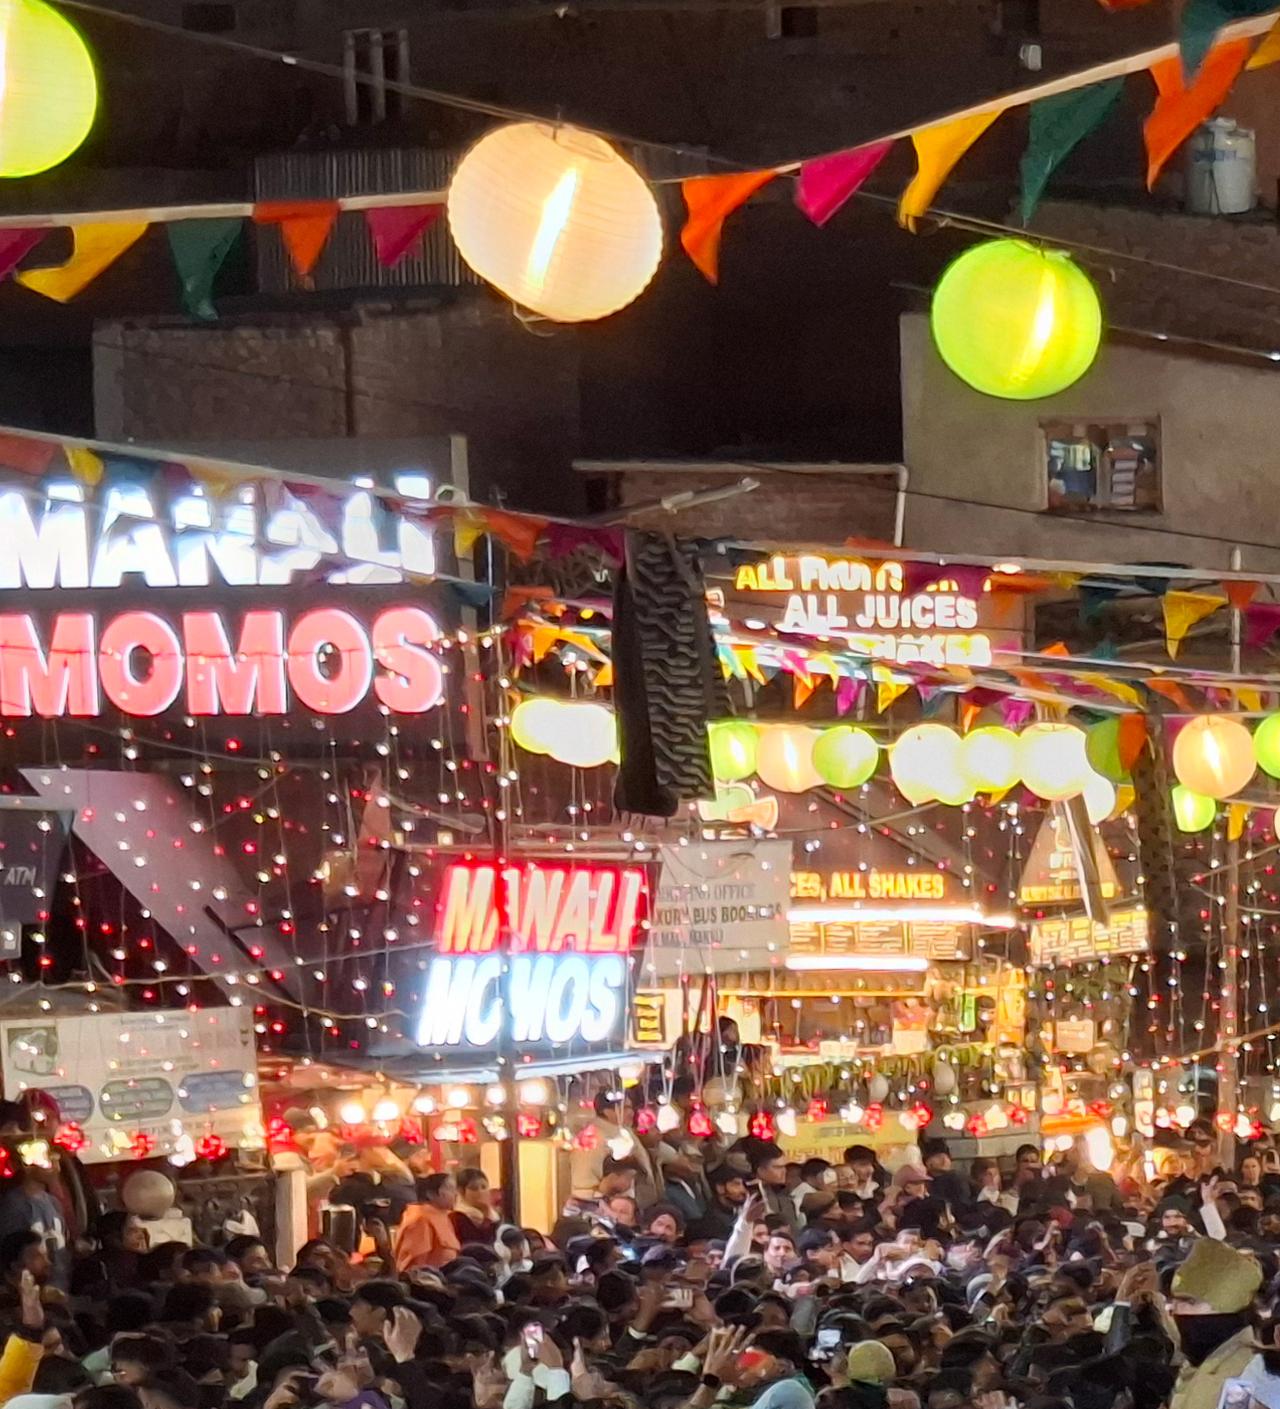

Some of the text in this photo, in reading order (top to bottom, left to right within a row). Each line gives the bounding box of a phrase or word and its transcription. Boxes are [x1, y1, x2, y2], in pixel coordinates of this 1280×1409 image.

[0, 477, 436, 588] MANALI
[736, 556, 794, 590] ALL
[783, 594, 979, 629] ALL JUICES
[0, 606, 445, 717] MOMOS
[3, 865, 37, 886] ATM
[830, 873, 865, 898] ALL
[869, 872, 944, 899] SHAKES
